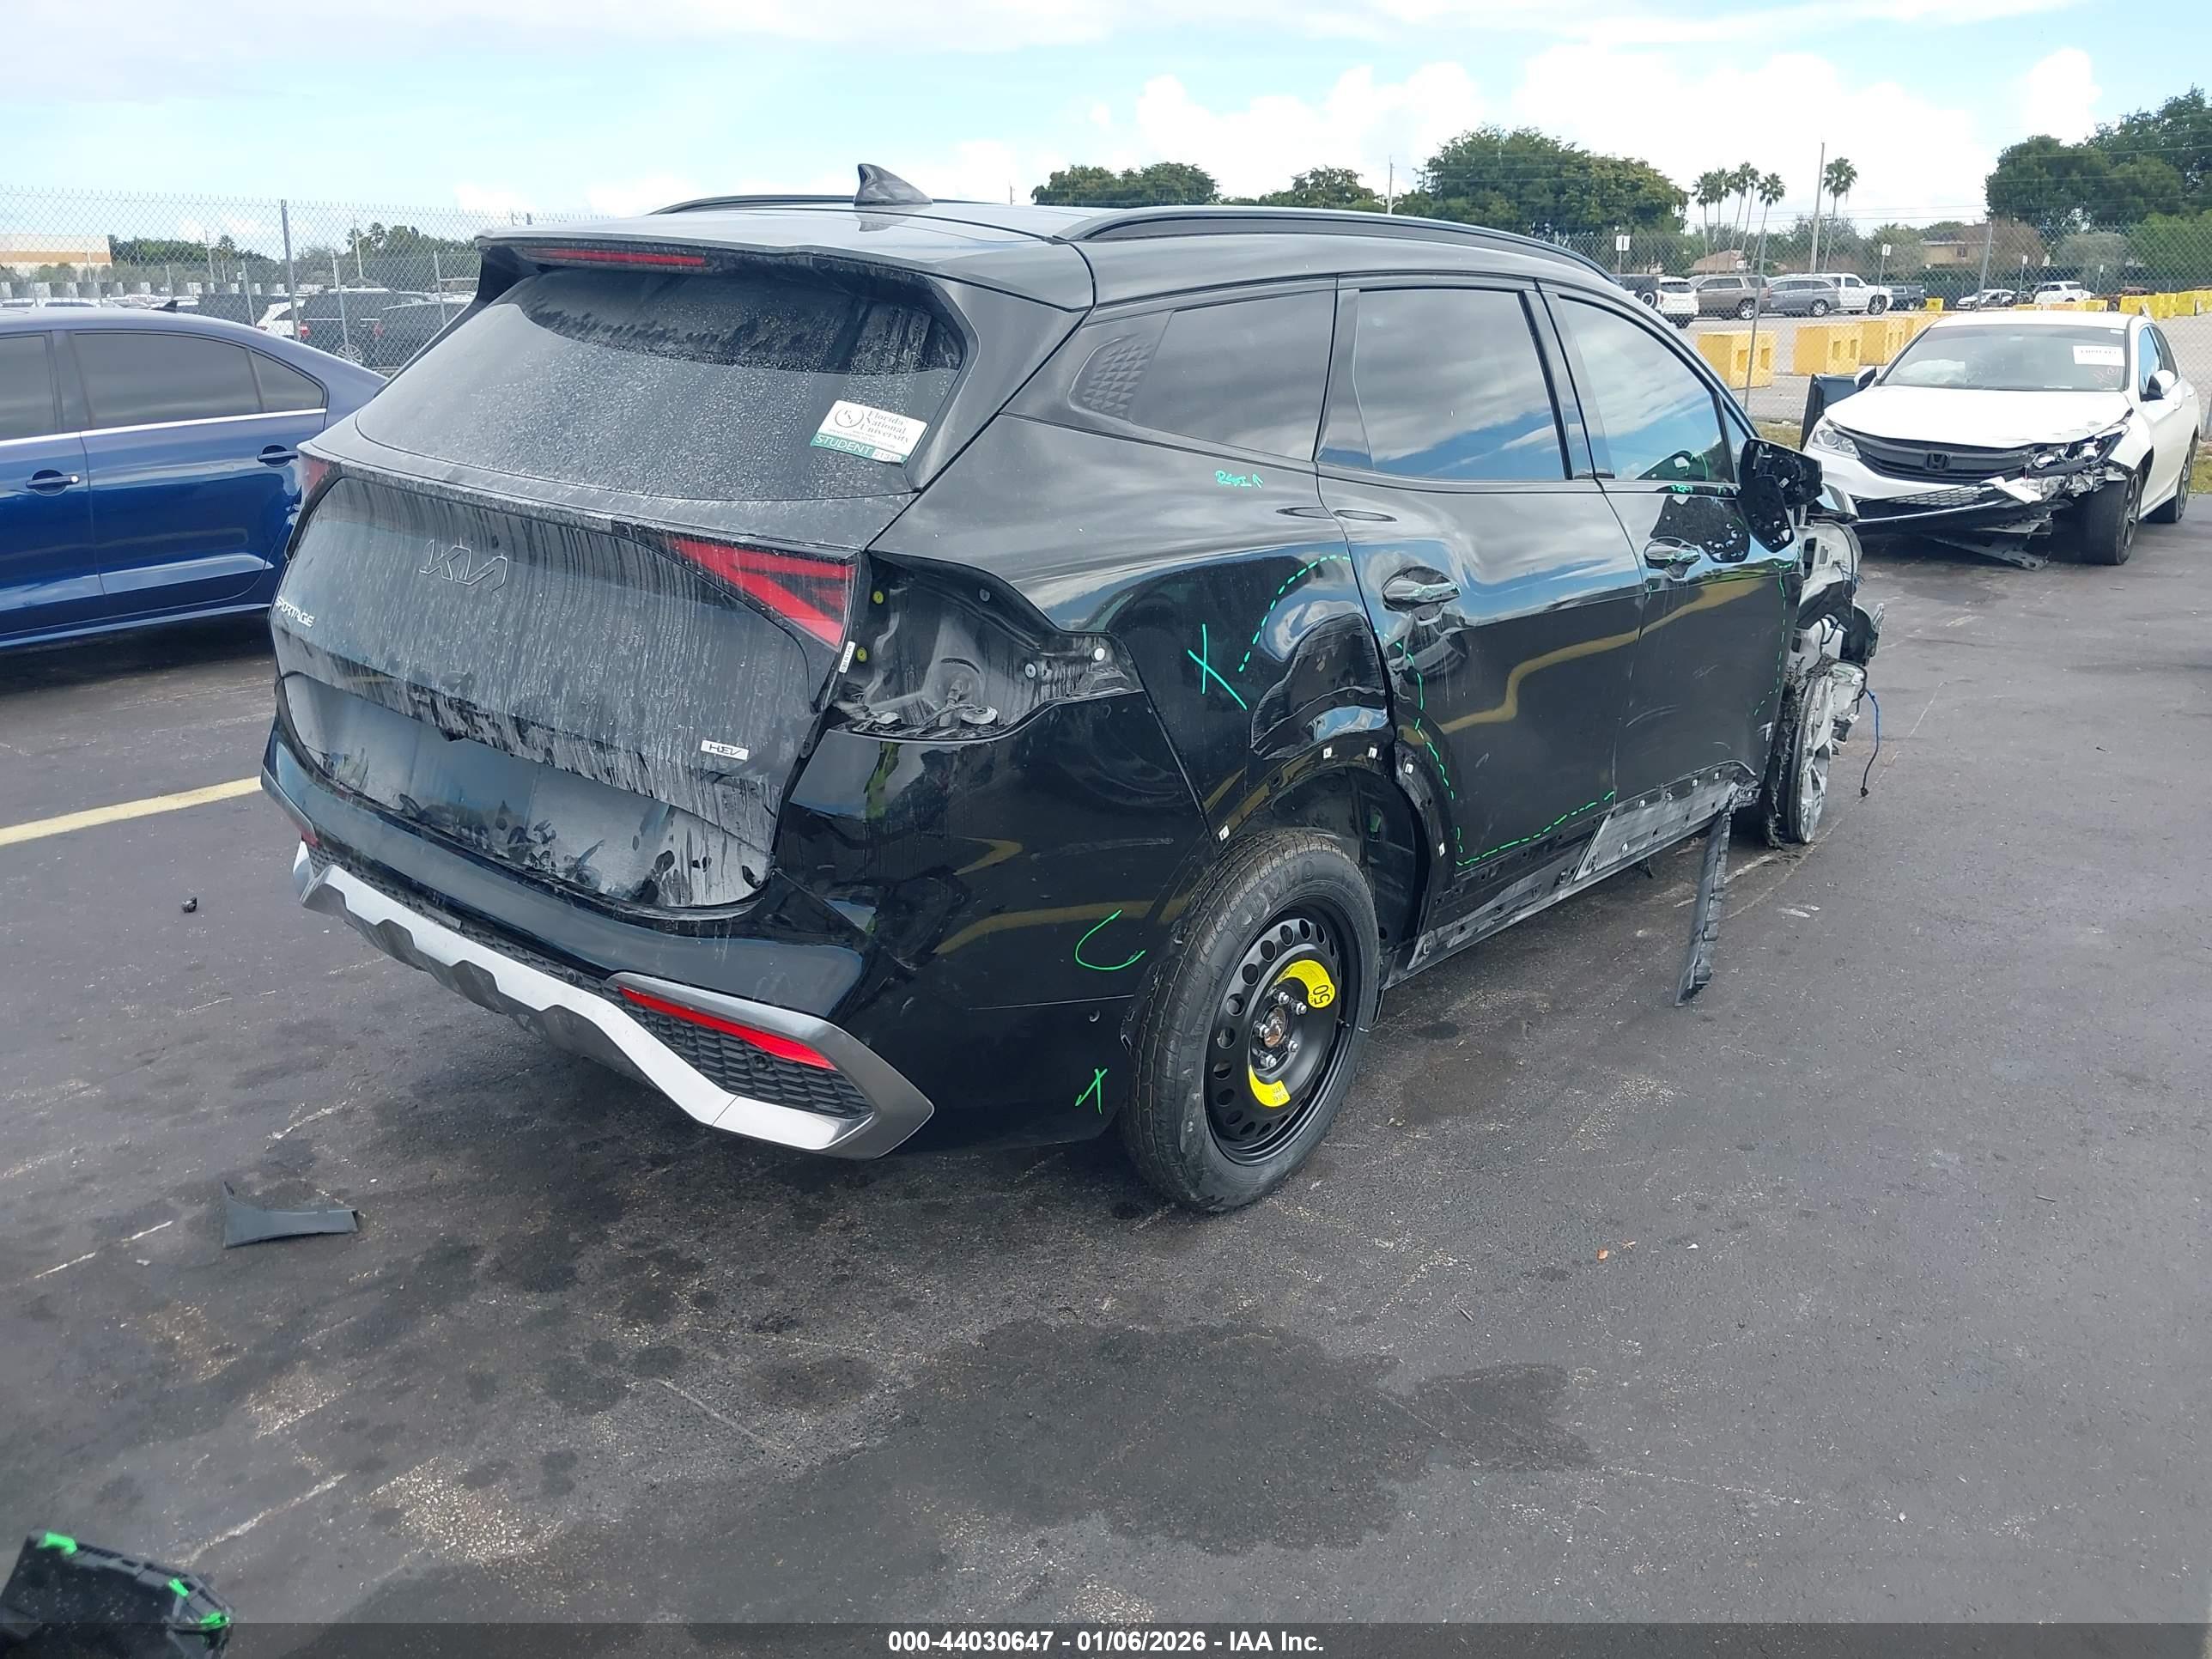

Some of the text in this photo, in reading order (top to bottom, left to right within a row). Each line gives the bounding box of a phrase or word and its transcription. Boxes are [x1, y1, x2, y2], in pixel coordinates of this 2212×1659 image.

[866, 417, 907, 434] National
[867, 410, 904, 426] Florida
[815, 434, 874, 455] STUDENT
[860, 423, 909, 445] University
[418, 538, 508, 592] KIA
[709, 743, 743, 756] HEV
[1312, 984, 1331, 1006] 50
